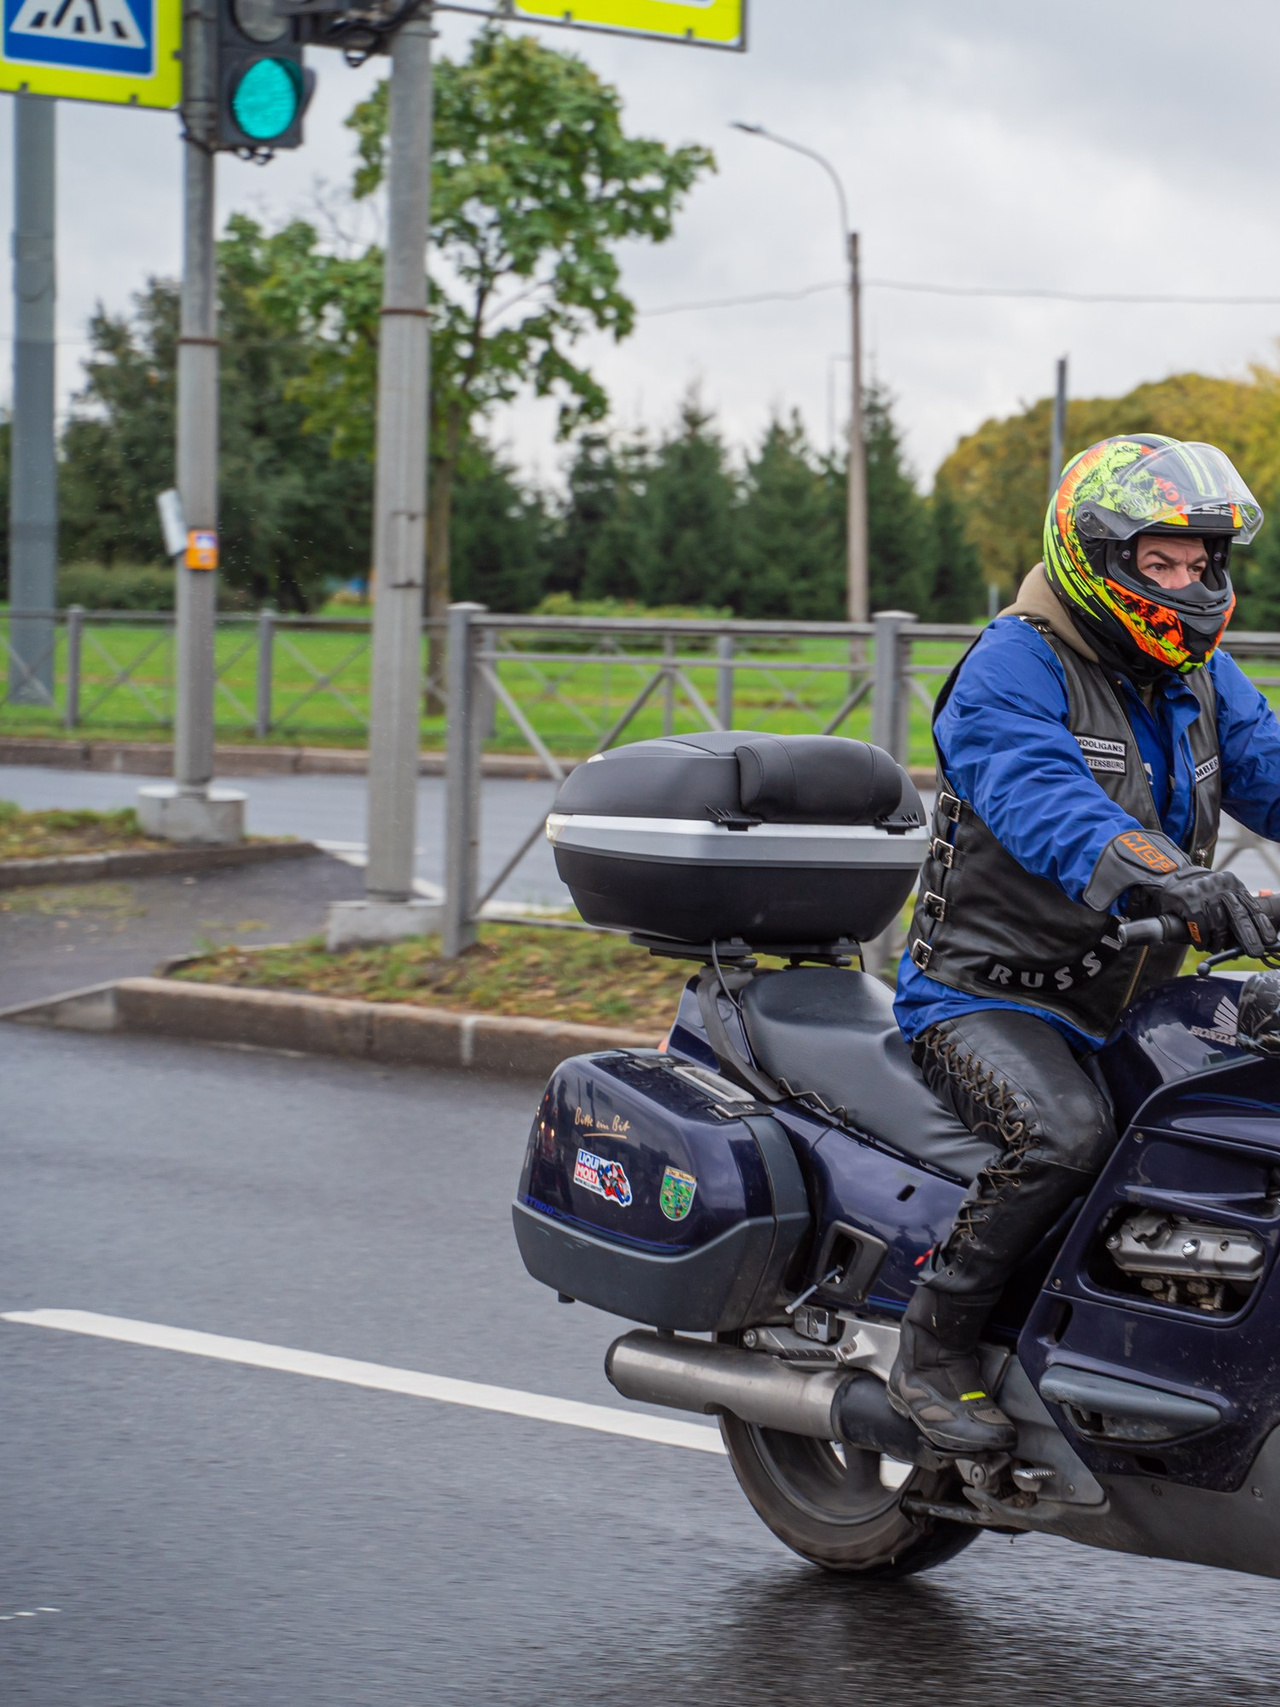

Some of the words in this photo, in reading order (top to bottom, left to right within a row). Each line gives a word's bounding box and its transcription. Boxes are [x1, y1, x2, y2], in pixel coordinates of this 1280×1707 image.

[1086, 758, 1124, 770] ETERSBURG
[1195, 758, 1218, 779] MBER
[1119, 831, 1178, 874] MCP
[1189, 1025, 1237, 1047] HONDA
[574, 1106, 593, 1127] Bitte
[612, 1115, 630, 1132] Bit
[578, 1151, 600, 1171] LIQUI
[575, 1163, 598, 1184] MOLY
